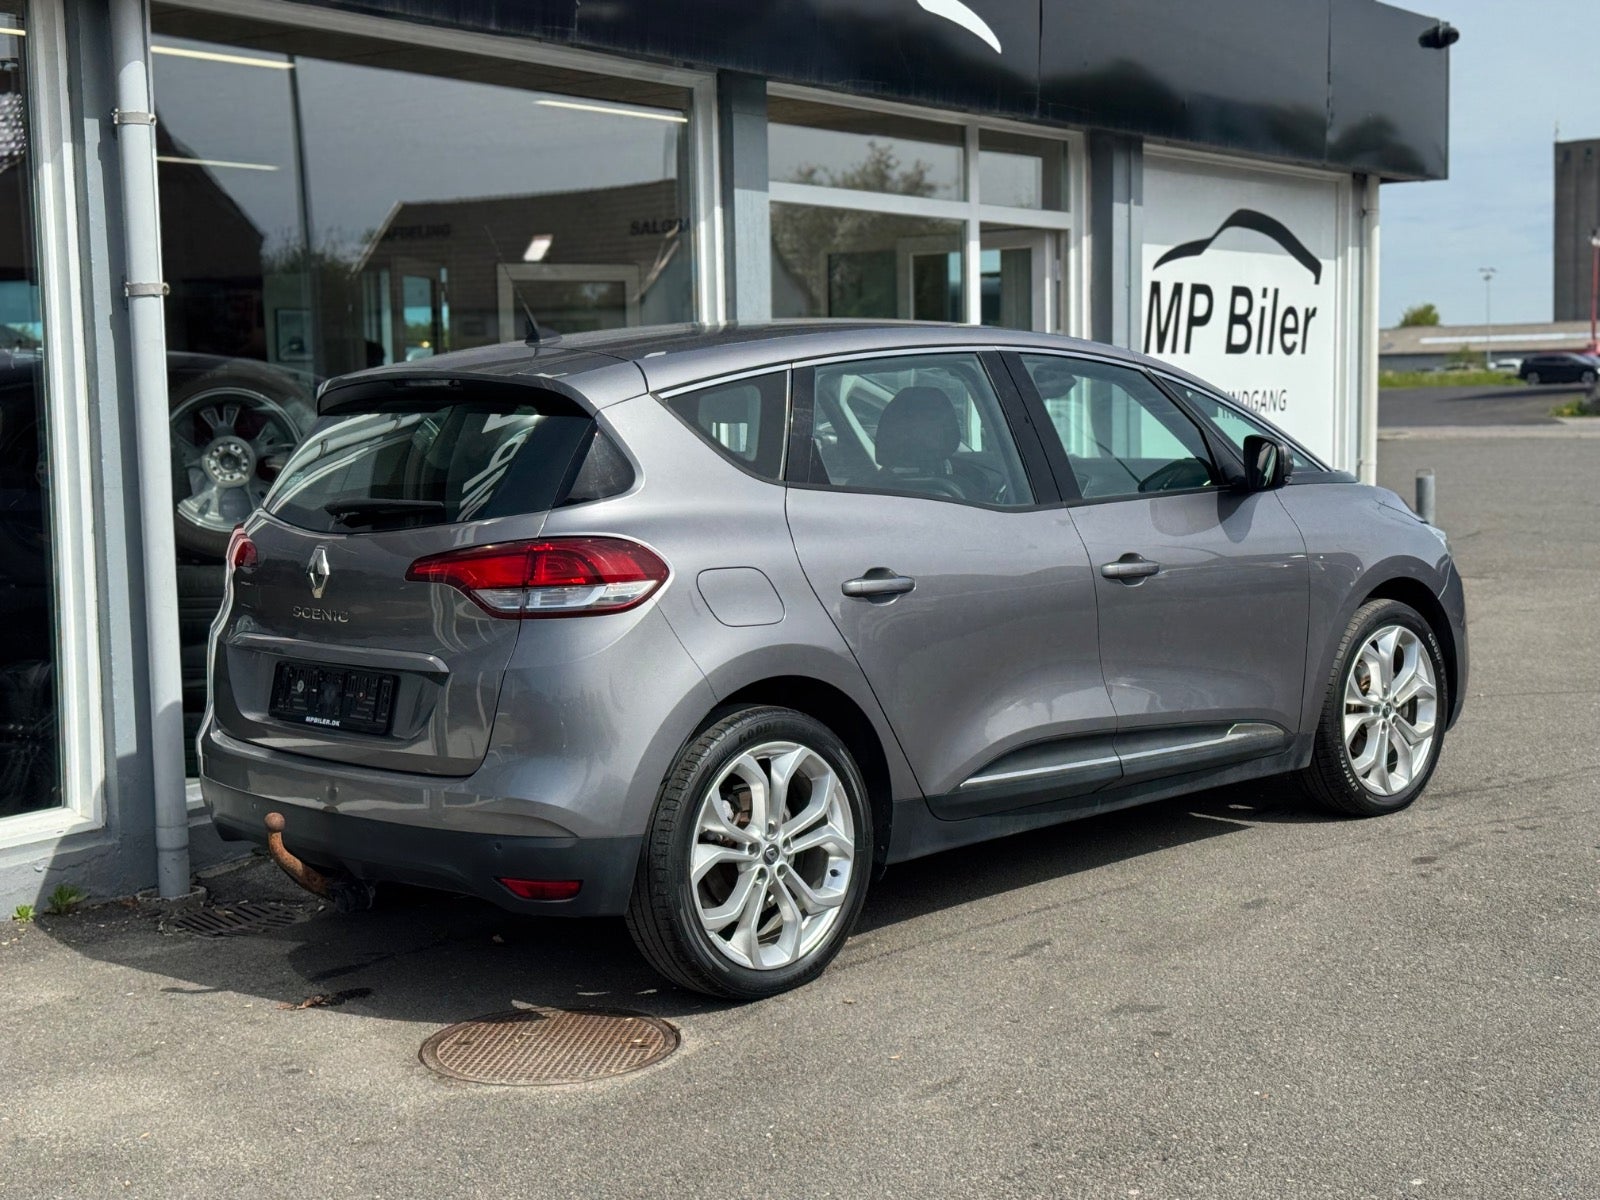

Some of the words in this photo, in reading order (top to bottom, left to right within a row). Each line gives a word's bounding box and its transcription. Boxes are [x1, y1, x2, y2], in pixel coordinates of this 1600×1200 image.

[1144, 280, 1214, 354] MP
[1225, 285, 1317, 356] Biler
[292, 606, 350, 623] SCENIC
[305, 716, 340, 727] MPBILER.DK
